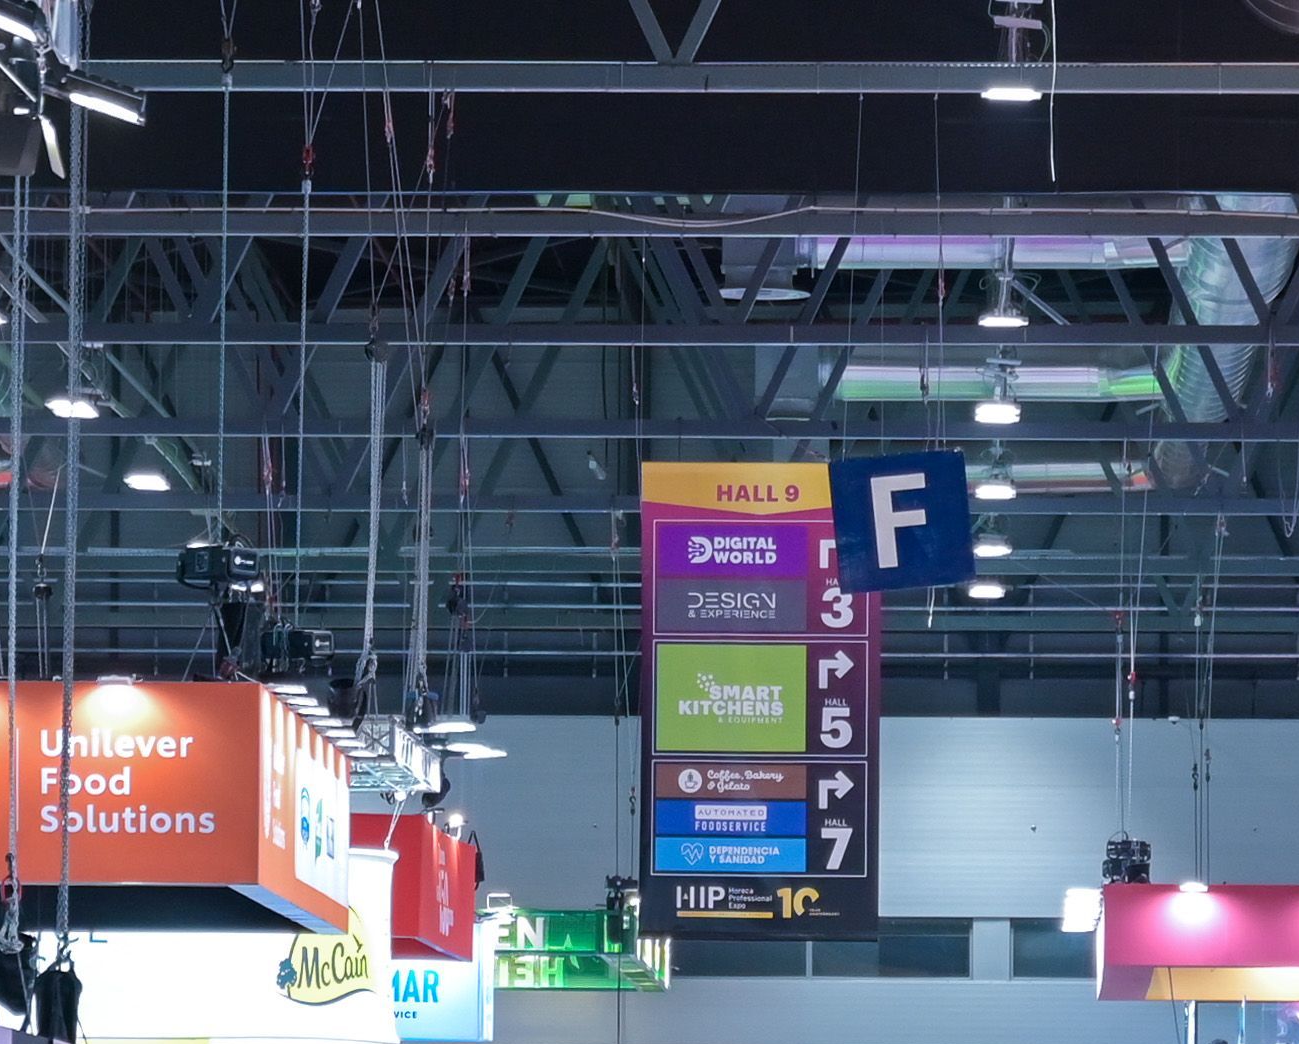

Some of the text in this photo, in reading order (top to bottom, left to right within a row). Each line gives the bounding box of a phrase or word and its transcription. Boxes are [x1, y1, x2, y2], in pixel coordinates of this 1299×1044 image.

[716, 484, 800, 502] HALL 9
[870, 472, 927, 569] F
[714, 536, 776, 550] DIGITAL
[714, 551, 777, 565] WORLD
[825, 578, 839, 586] HA
[688, 592, 776, 609] DESIGN
[820, 587, 854, 629] 3
[688, 609, 776, 619] & EXPERIENCE
[709, 685, 783, 701] SMART
[678, 700, 784, 716] KITCHENS
[824, 698, 848, 707] HALL
[819, 707, 853, 748] 5
[39, 727, 194, 758] Unilever
[40, 766, 131, 796] Food
[745, 770, 784, 783] Bakery
[716, 781, 751, 793] Gelato
[39, 804, 216, 834] Solutions
[697, 808, 765, 817] AUTOMATED
[694, 820, 767, 832] FOODSERVICE
[824, 818, 848, 828] HALL
[708, 846, 780, 856] DEPENDENCIA
[820, 827, 854, 870] 7
[708, 855, 765, 865] Y SANIDAD
[675, 885, 726, 909] HIP
[296, 942, 369, 989] McCain
